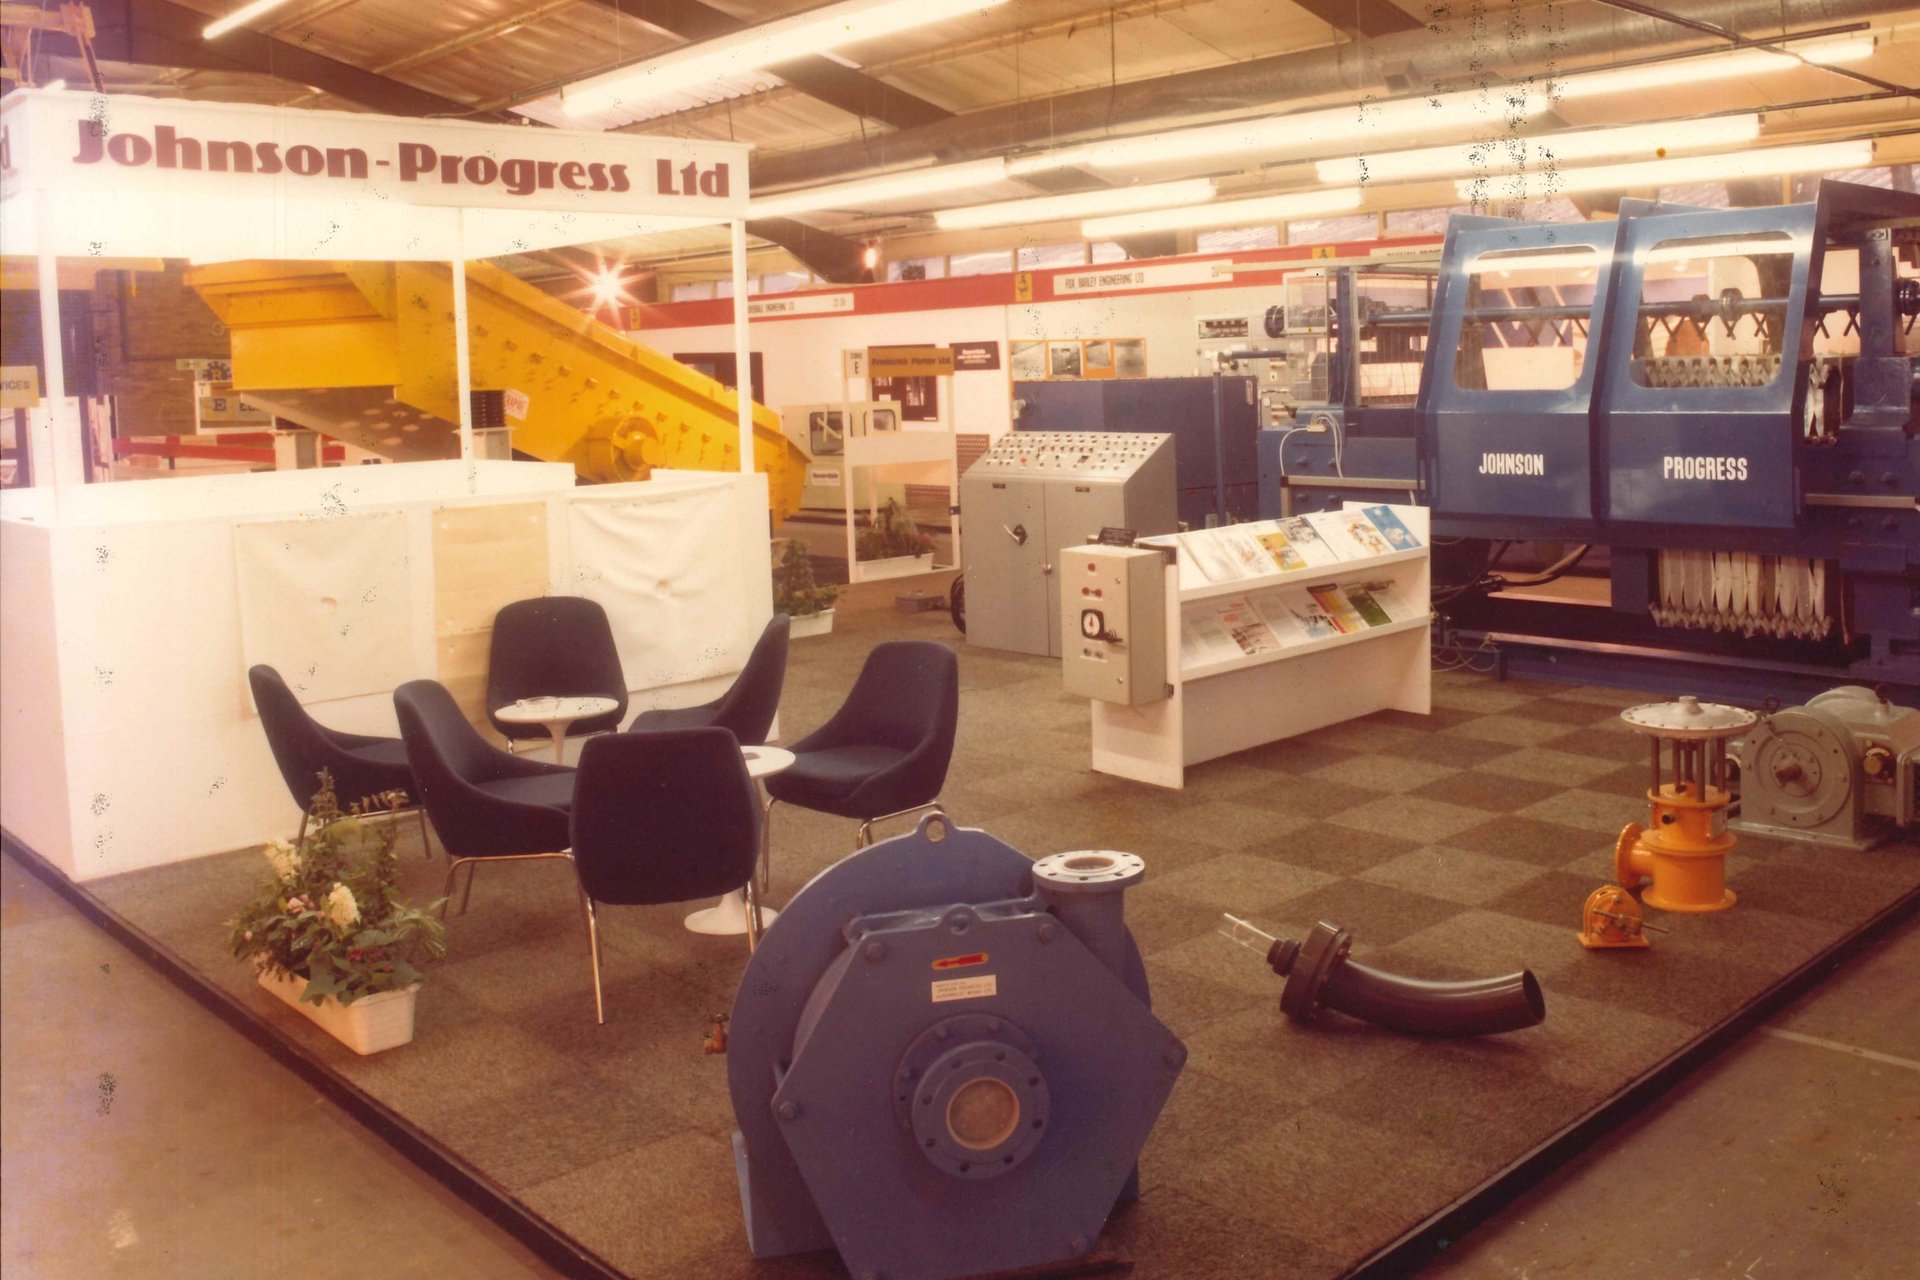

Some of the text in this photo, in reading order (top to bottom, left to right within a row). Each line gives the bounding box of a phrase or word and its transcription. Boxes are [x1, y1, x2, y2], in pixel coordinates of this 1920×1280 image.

[657, 158, 729, 197] Ltd
[1099, 273, 1133, 287] ENGINEERING
[1135, 272, 1145, 284] LTD
[213, 398, 227, 412] E
[1479, 453, 1544, 476] JOHNSON
[1663, 456, 1748, 481] PROGRESS
